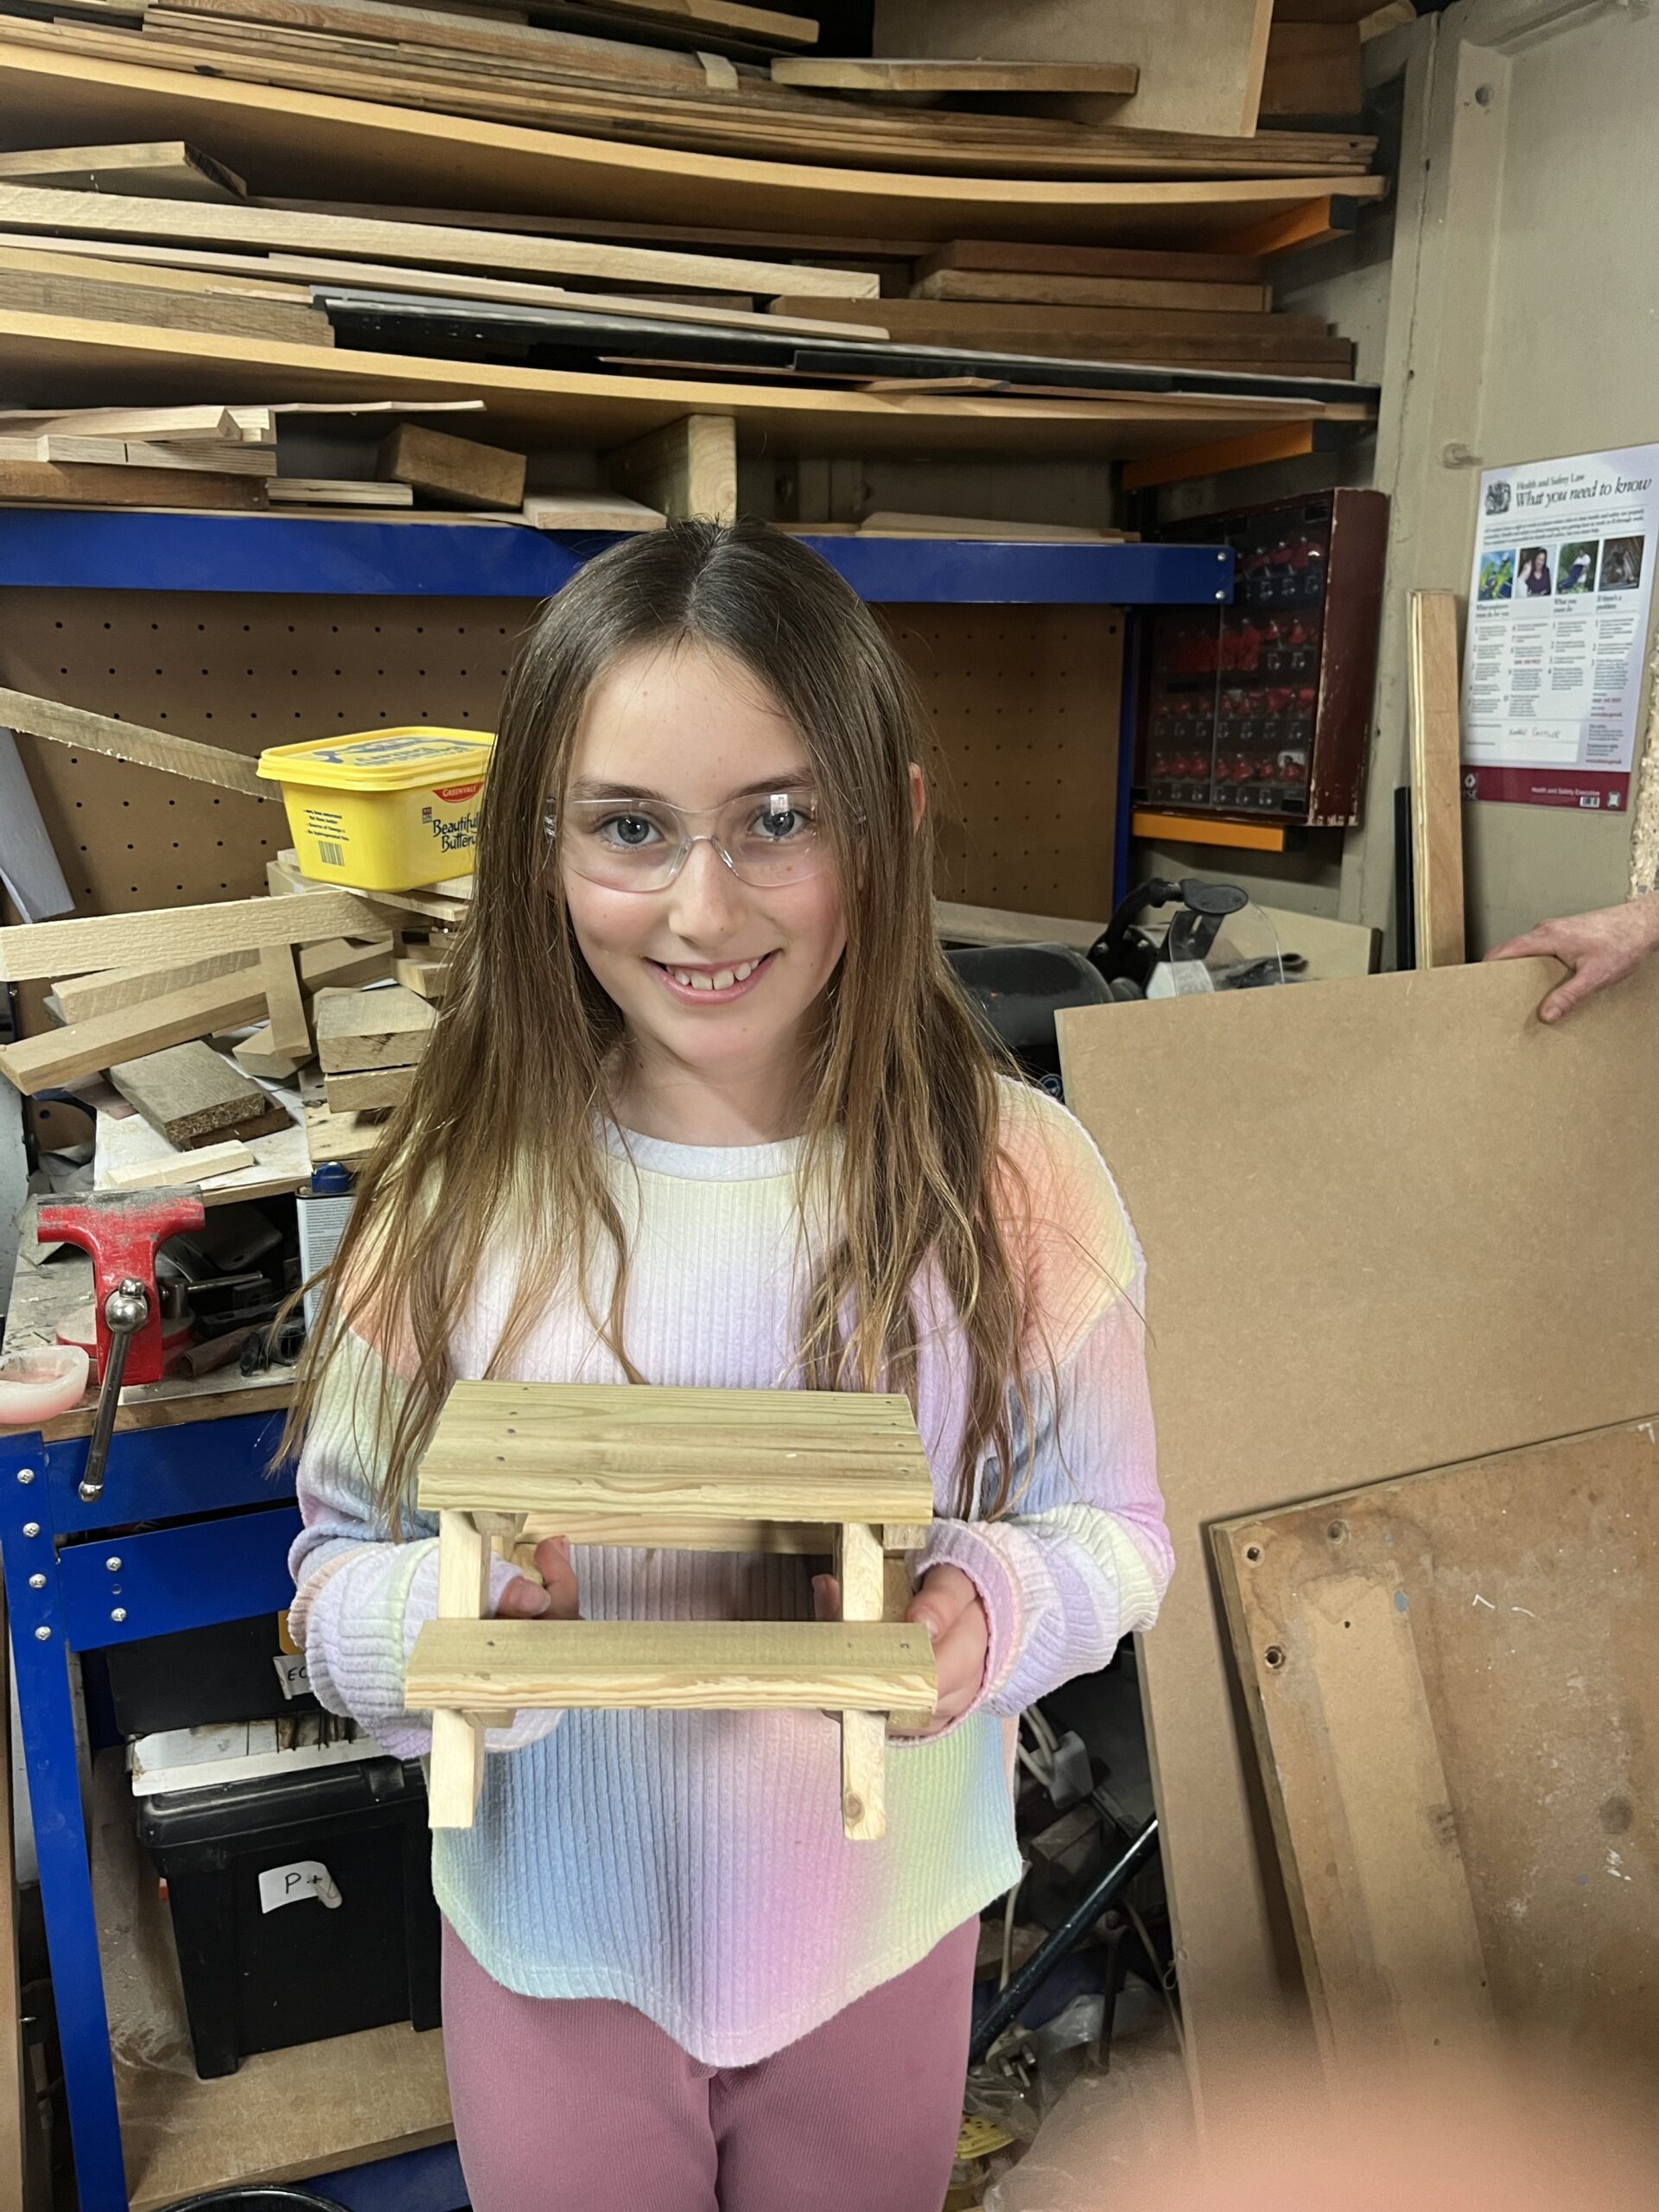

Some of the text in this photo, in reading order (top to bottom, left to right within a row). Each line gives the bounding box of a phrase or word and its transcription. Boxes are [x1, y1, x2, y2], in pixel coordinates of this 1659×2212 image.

[1516, 473, 1585, 491] Health and Safety Law
[1516, 476, 1652, 508] What you need to know
[442, 785, 477, 798] GREENVALE
